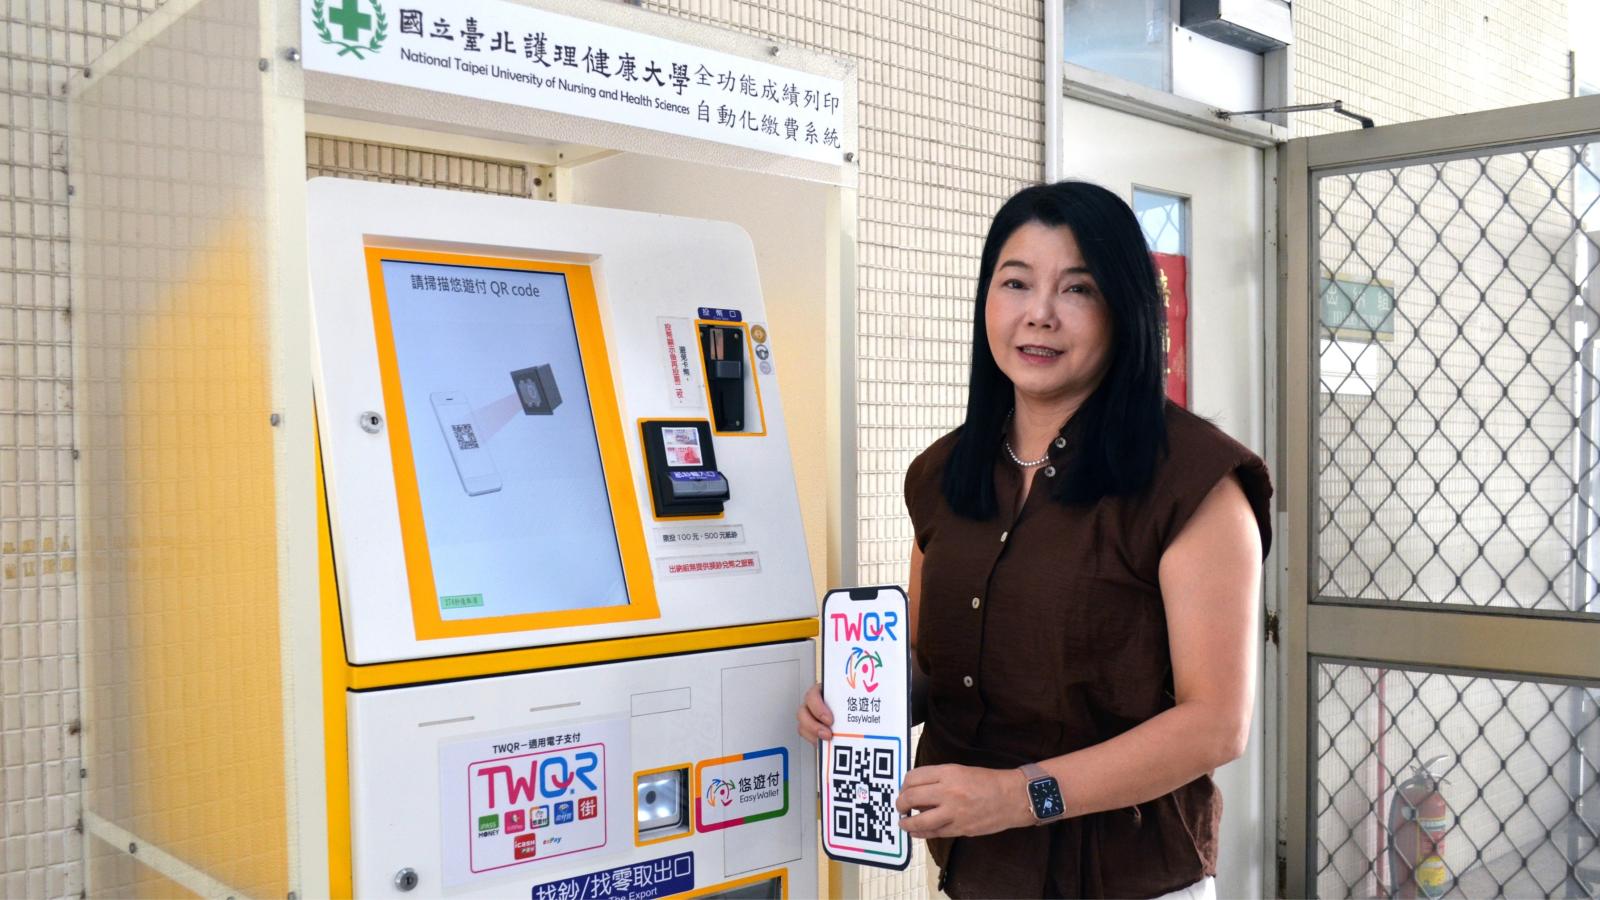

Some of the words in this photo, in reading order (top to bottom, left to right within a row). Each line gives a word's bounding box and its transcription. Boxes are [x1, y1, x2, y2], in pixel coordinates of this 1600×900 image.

[400, 9, 691, 96] 國立臺北護理健康大學
[401, 48, 451, 69] National
[454, 57, 489, 76] Taipei
[491, 66, 543, 88] University
[546, 77, 556, 89] of
[559, 80, 596, 98] Nursing
[598, 88, 618, 101] and
[621, 92, 652, 107] Health
[655, 97, 690, 115] Sciences
[694, 64, 840, 115] 全功能成績列印
[697, 99, 841, 149] 自動化繳費系統
[410, 274, 487, 295] 請掃描悠遊付
[490, 281, 509, 297] QR
[511, 283, 540, 297] code
[677, 533, 692, 541] 100
[830, 611, 898, 642] TWQR
[847, 696, 882, 713] 悠遊付
[847, 713, 881, 724] EasyWallet
[477, 751, 599, 809] TWQR
[738, 770, 780, 793] 悠遊付
[739, 788, 780, 804] EasyWallet
[579, 800, 596, 817] 街
[478, 829, 500, 838] MONEY
[629, 887, 658, 900] Export
